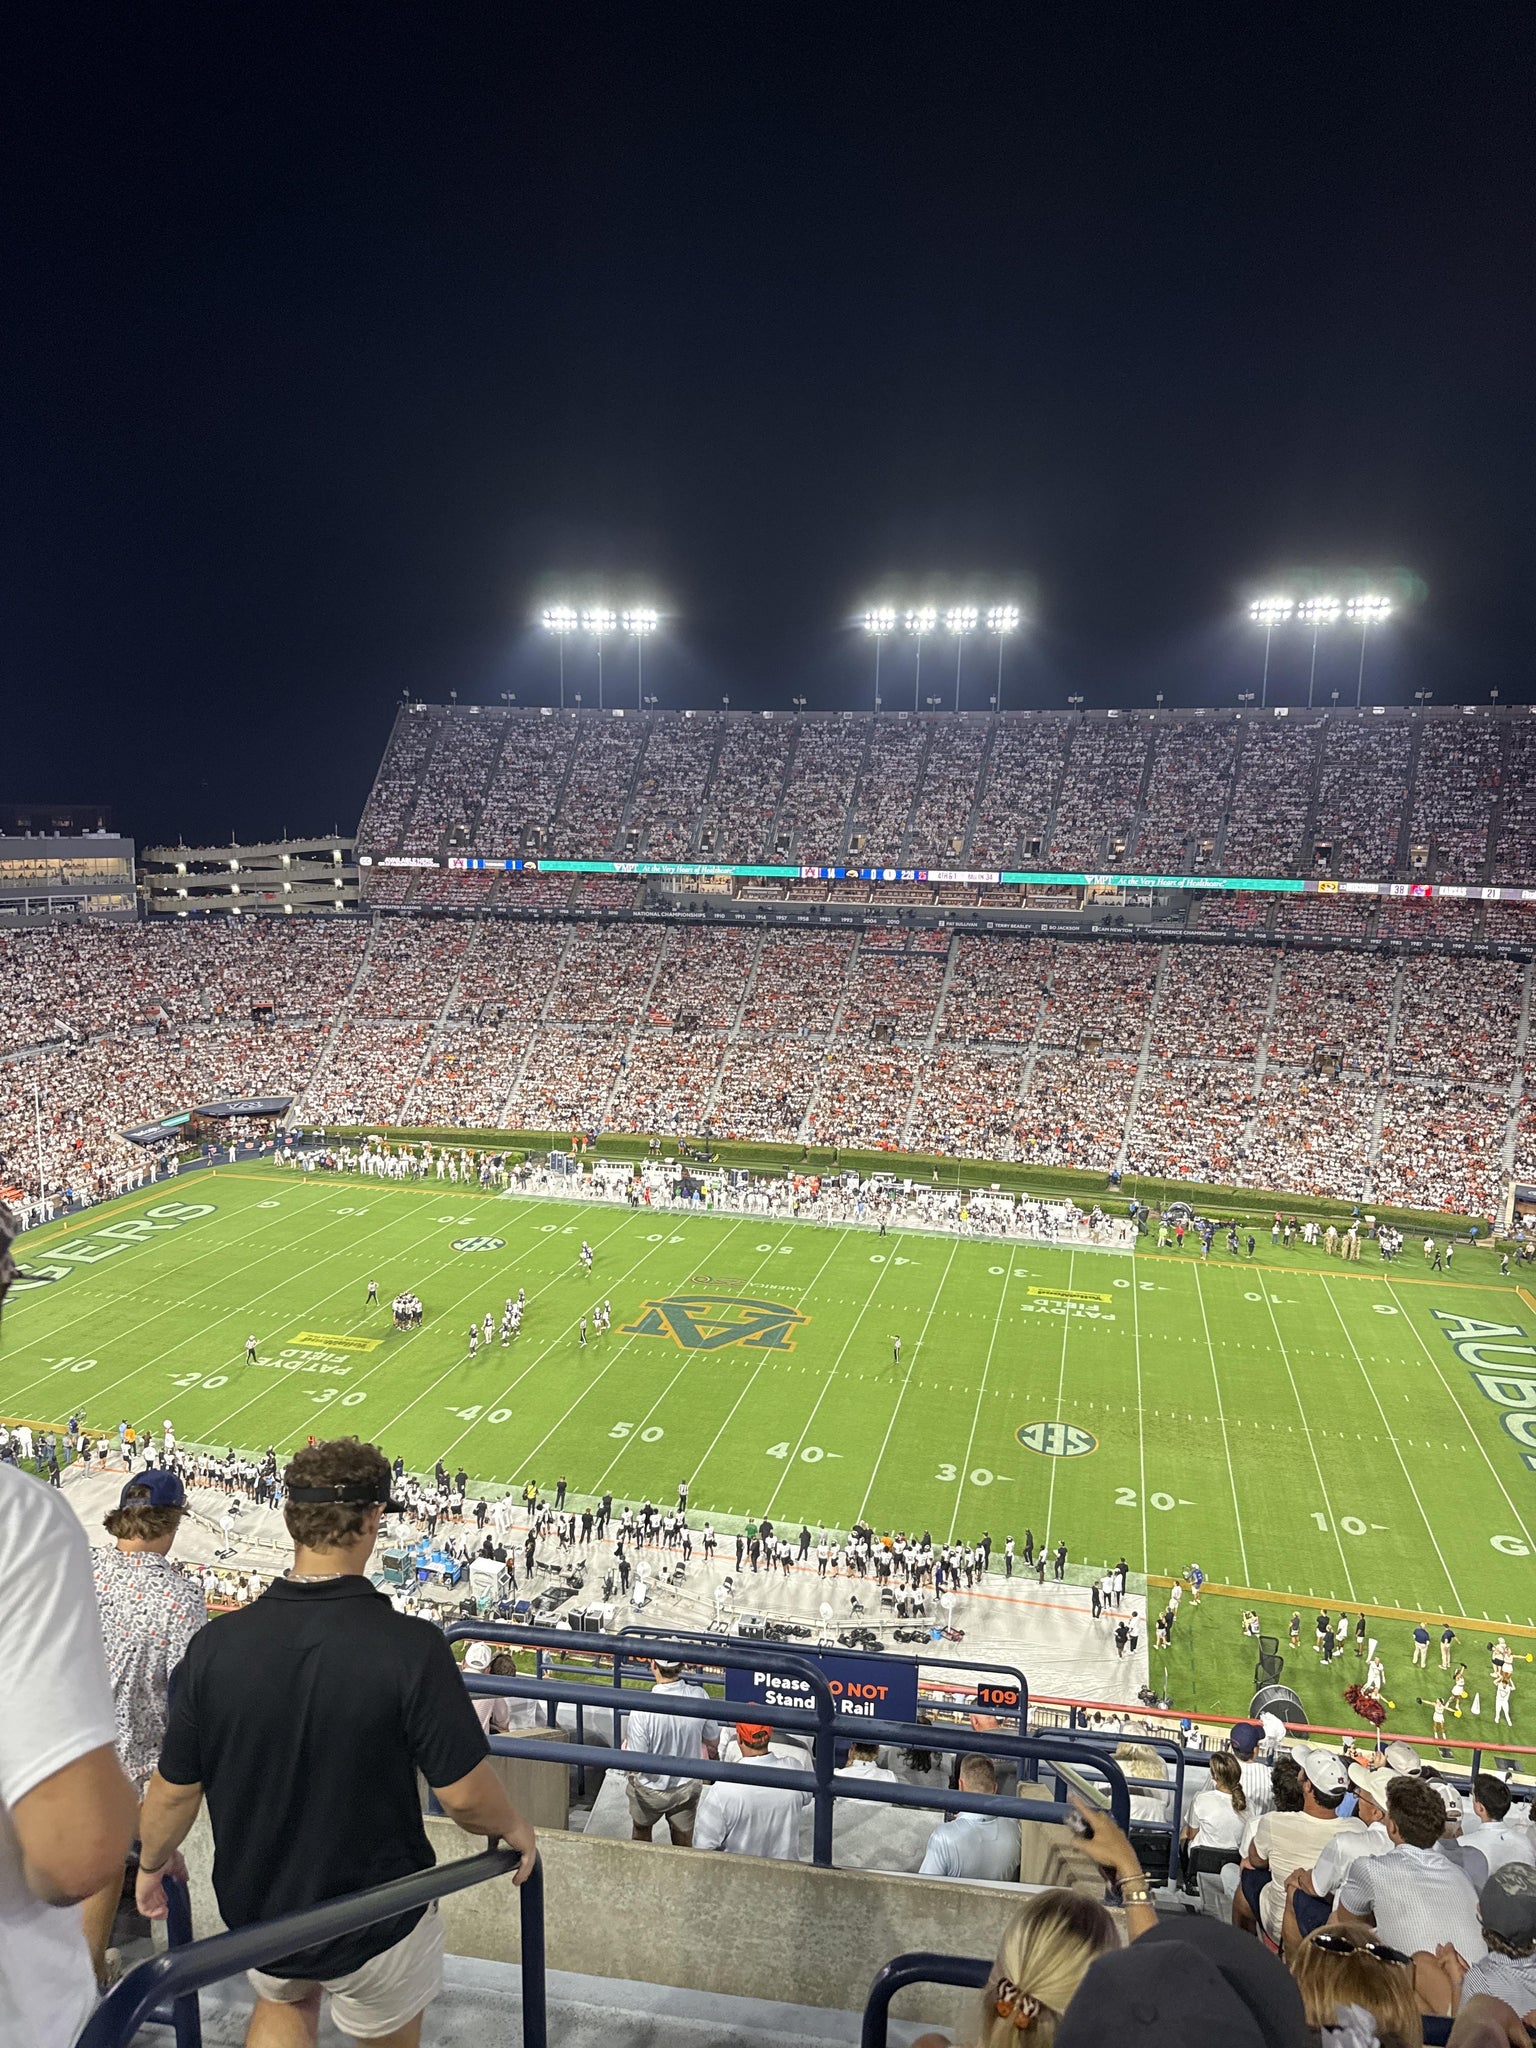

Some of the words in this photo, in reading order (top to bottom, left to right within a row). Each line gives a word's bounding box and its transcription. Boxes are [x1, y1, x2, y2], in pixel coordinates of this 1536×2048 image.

[621, 863, 638, 872] MPT
[642, 864, 651, 872] At
[662, 865, 676, 874] Very
[694, 866, 700, 874] of
[1094, 875, 1114, 885] MPT
[1118, 877, 1127, 885] At
[1139, 878, 1155, 886] Very
[1156, 878, 1176, 886] Heart
[1177, 878, 1186, 887] of
[1394, 885, 1404, 894] 38
[1487, 889, 1496, 898] 21
[336, 1207, 369, 1216] 10
[437, 1216, 476, 1225] 20
[539, 1225, 579, 1234] 30
[451, 1236, 506, 1251] SEC
[646, 1233, 686, 1244] 40
[755, 1244, 795, 1254] 50
[869, 1254, 910, 1266] 40
[987, 1266, 1029, 1278] 30
[749, 1282, 806, 1292] AMERICA
[1113, 1279, 1154, 1291] 20
[1244, 1292, 1283, 1303] 10
[1020, 1304, 1066, 1315] DYE
[1033, 1299, 1100, 1311] FIELD
[1071, 1311, 1116, 1320] PAT
[252, 1356, 304, 1370] DYE
[280, 1349, 351, 1364] FIELD
[49, 1356, 97, 1372] 10
[301, 1362, 353, 1376] PAT
[172, 1372, 228, 1389] 20
[311, 1388, 367, 1406] 30
[456, 1405, 513, 1424] 40
[607, 1421, 664, 1442] 50
[1020, 1422, 1092, 1456] SEC
[765, 1441, 823, 1463] 40
[935, 1463, 993, 1486] 30
[1114, 1487, 1175, 1511] 20
[1311, 1512, 1367, 1536] 10
[1489, 1535, 1530, 1556] G
[753, 1672, 811, 1692] Please
[828, 1680, 844, 1696] O
[847, 1683, 889, 1701] NOT
[980, 1688, 1017, 1705] 109
[765, 1691, 816, 1710] Stand
[841, 1700, 875, 1717] Rail
